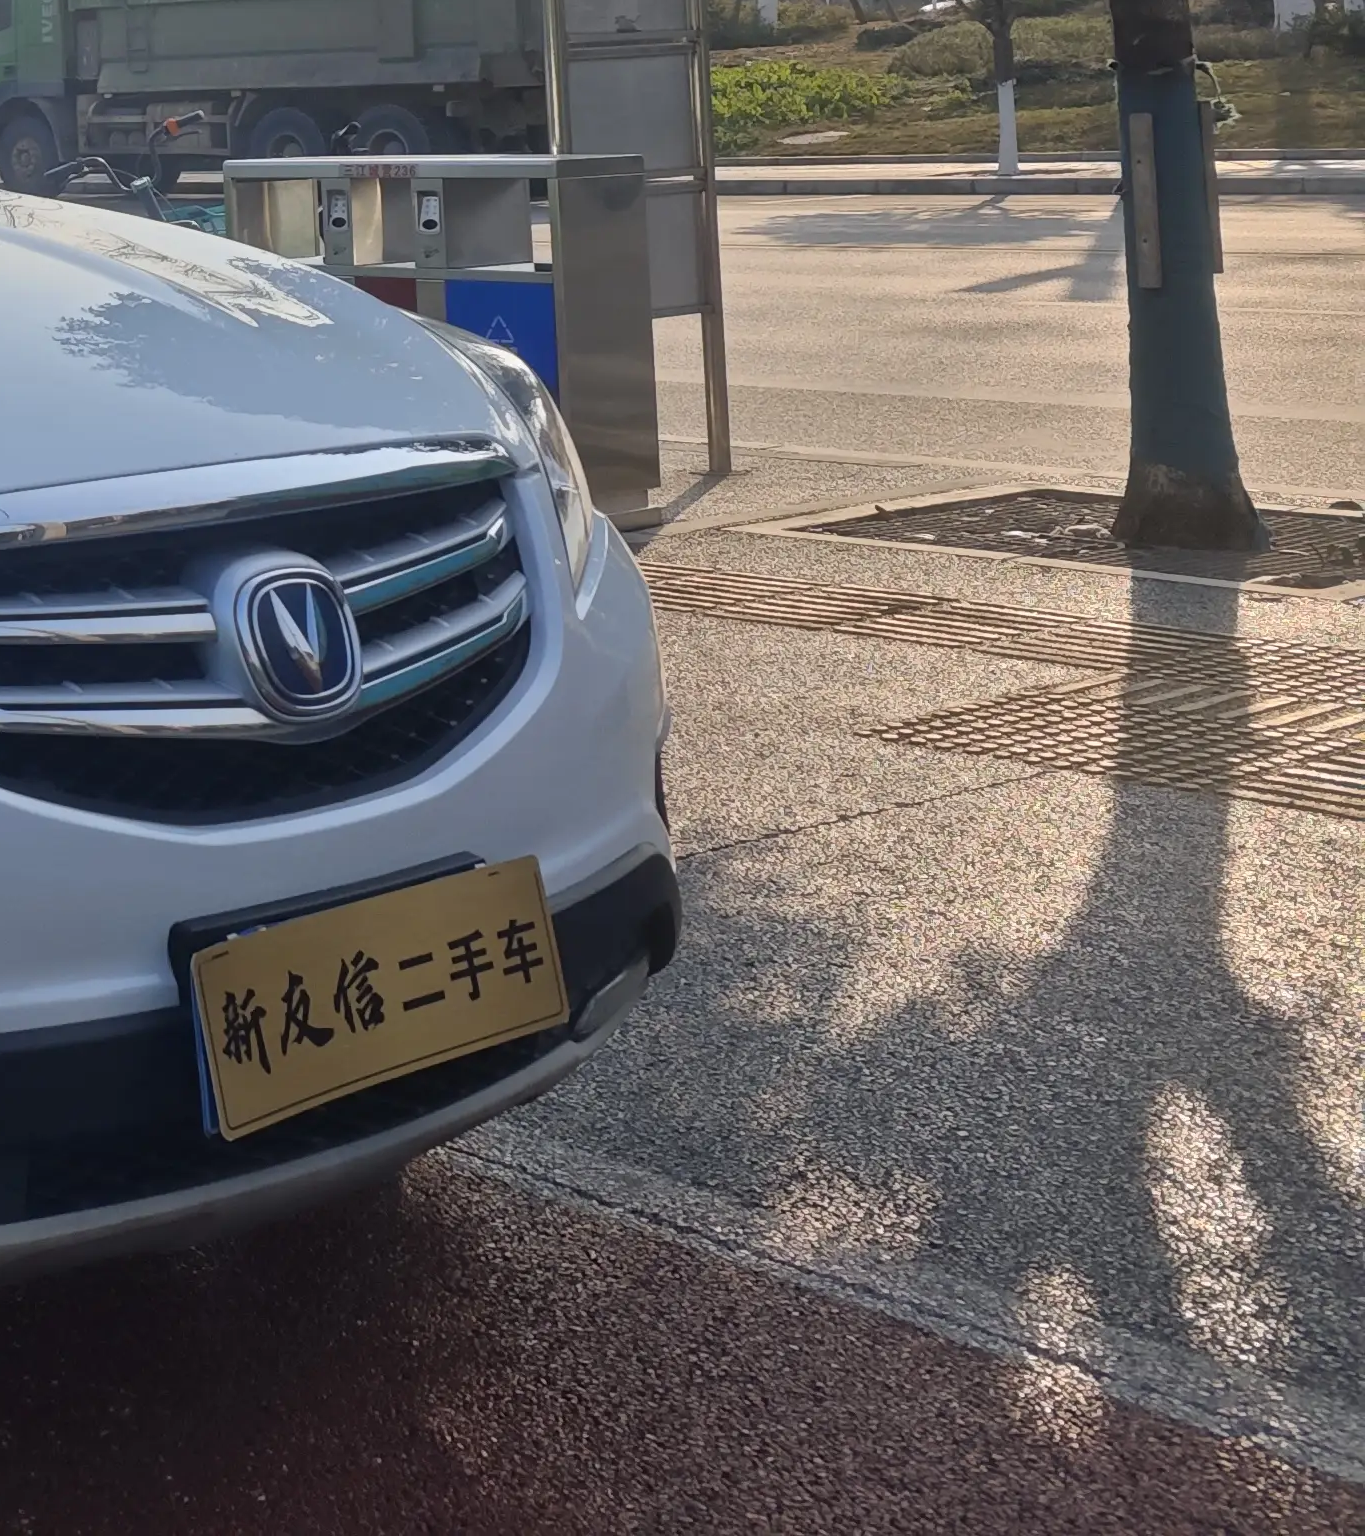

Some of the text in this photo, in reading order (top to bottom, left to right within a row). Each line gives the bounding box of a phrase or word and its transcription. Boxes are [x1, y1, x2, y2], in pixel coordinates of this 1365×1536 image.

[221, 918, 544, 1074] 新友信二手车
